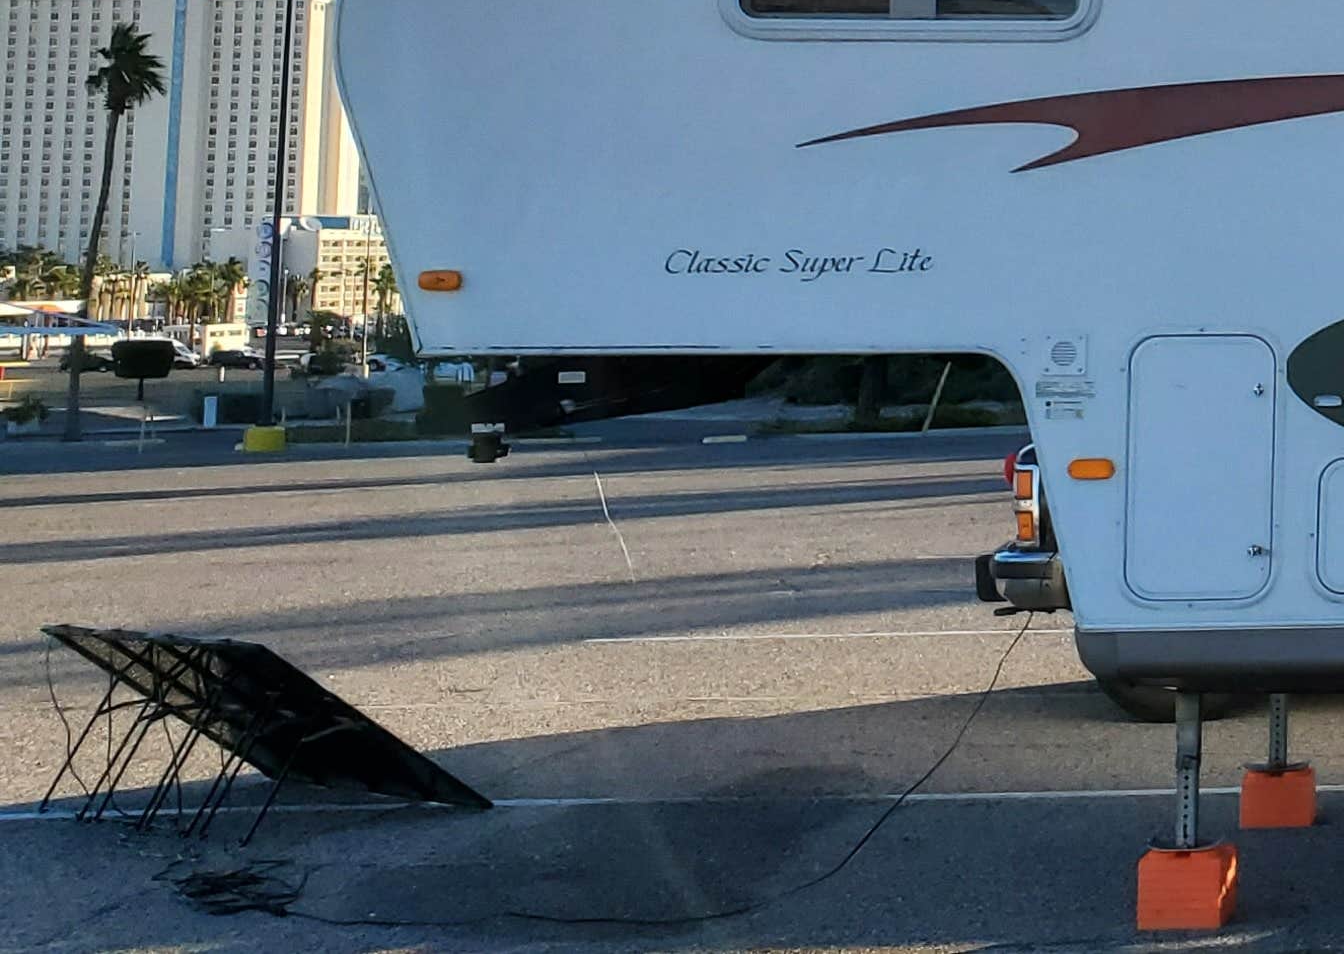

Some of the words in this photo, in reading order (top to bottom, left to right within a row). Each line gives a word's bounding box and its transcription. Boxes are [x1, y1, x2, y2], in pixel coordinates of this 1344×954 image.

[665, 249, 771, 275] Classic
[779, 249, 863, 282] Super
[868, 248, 933, 274] Lite
